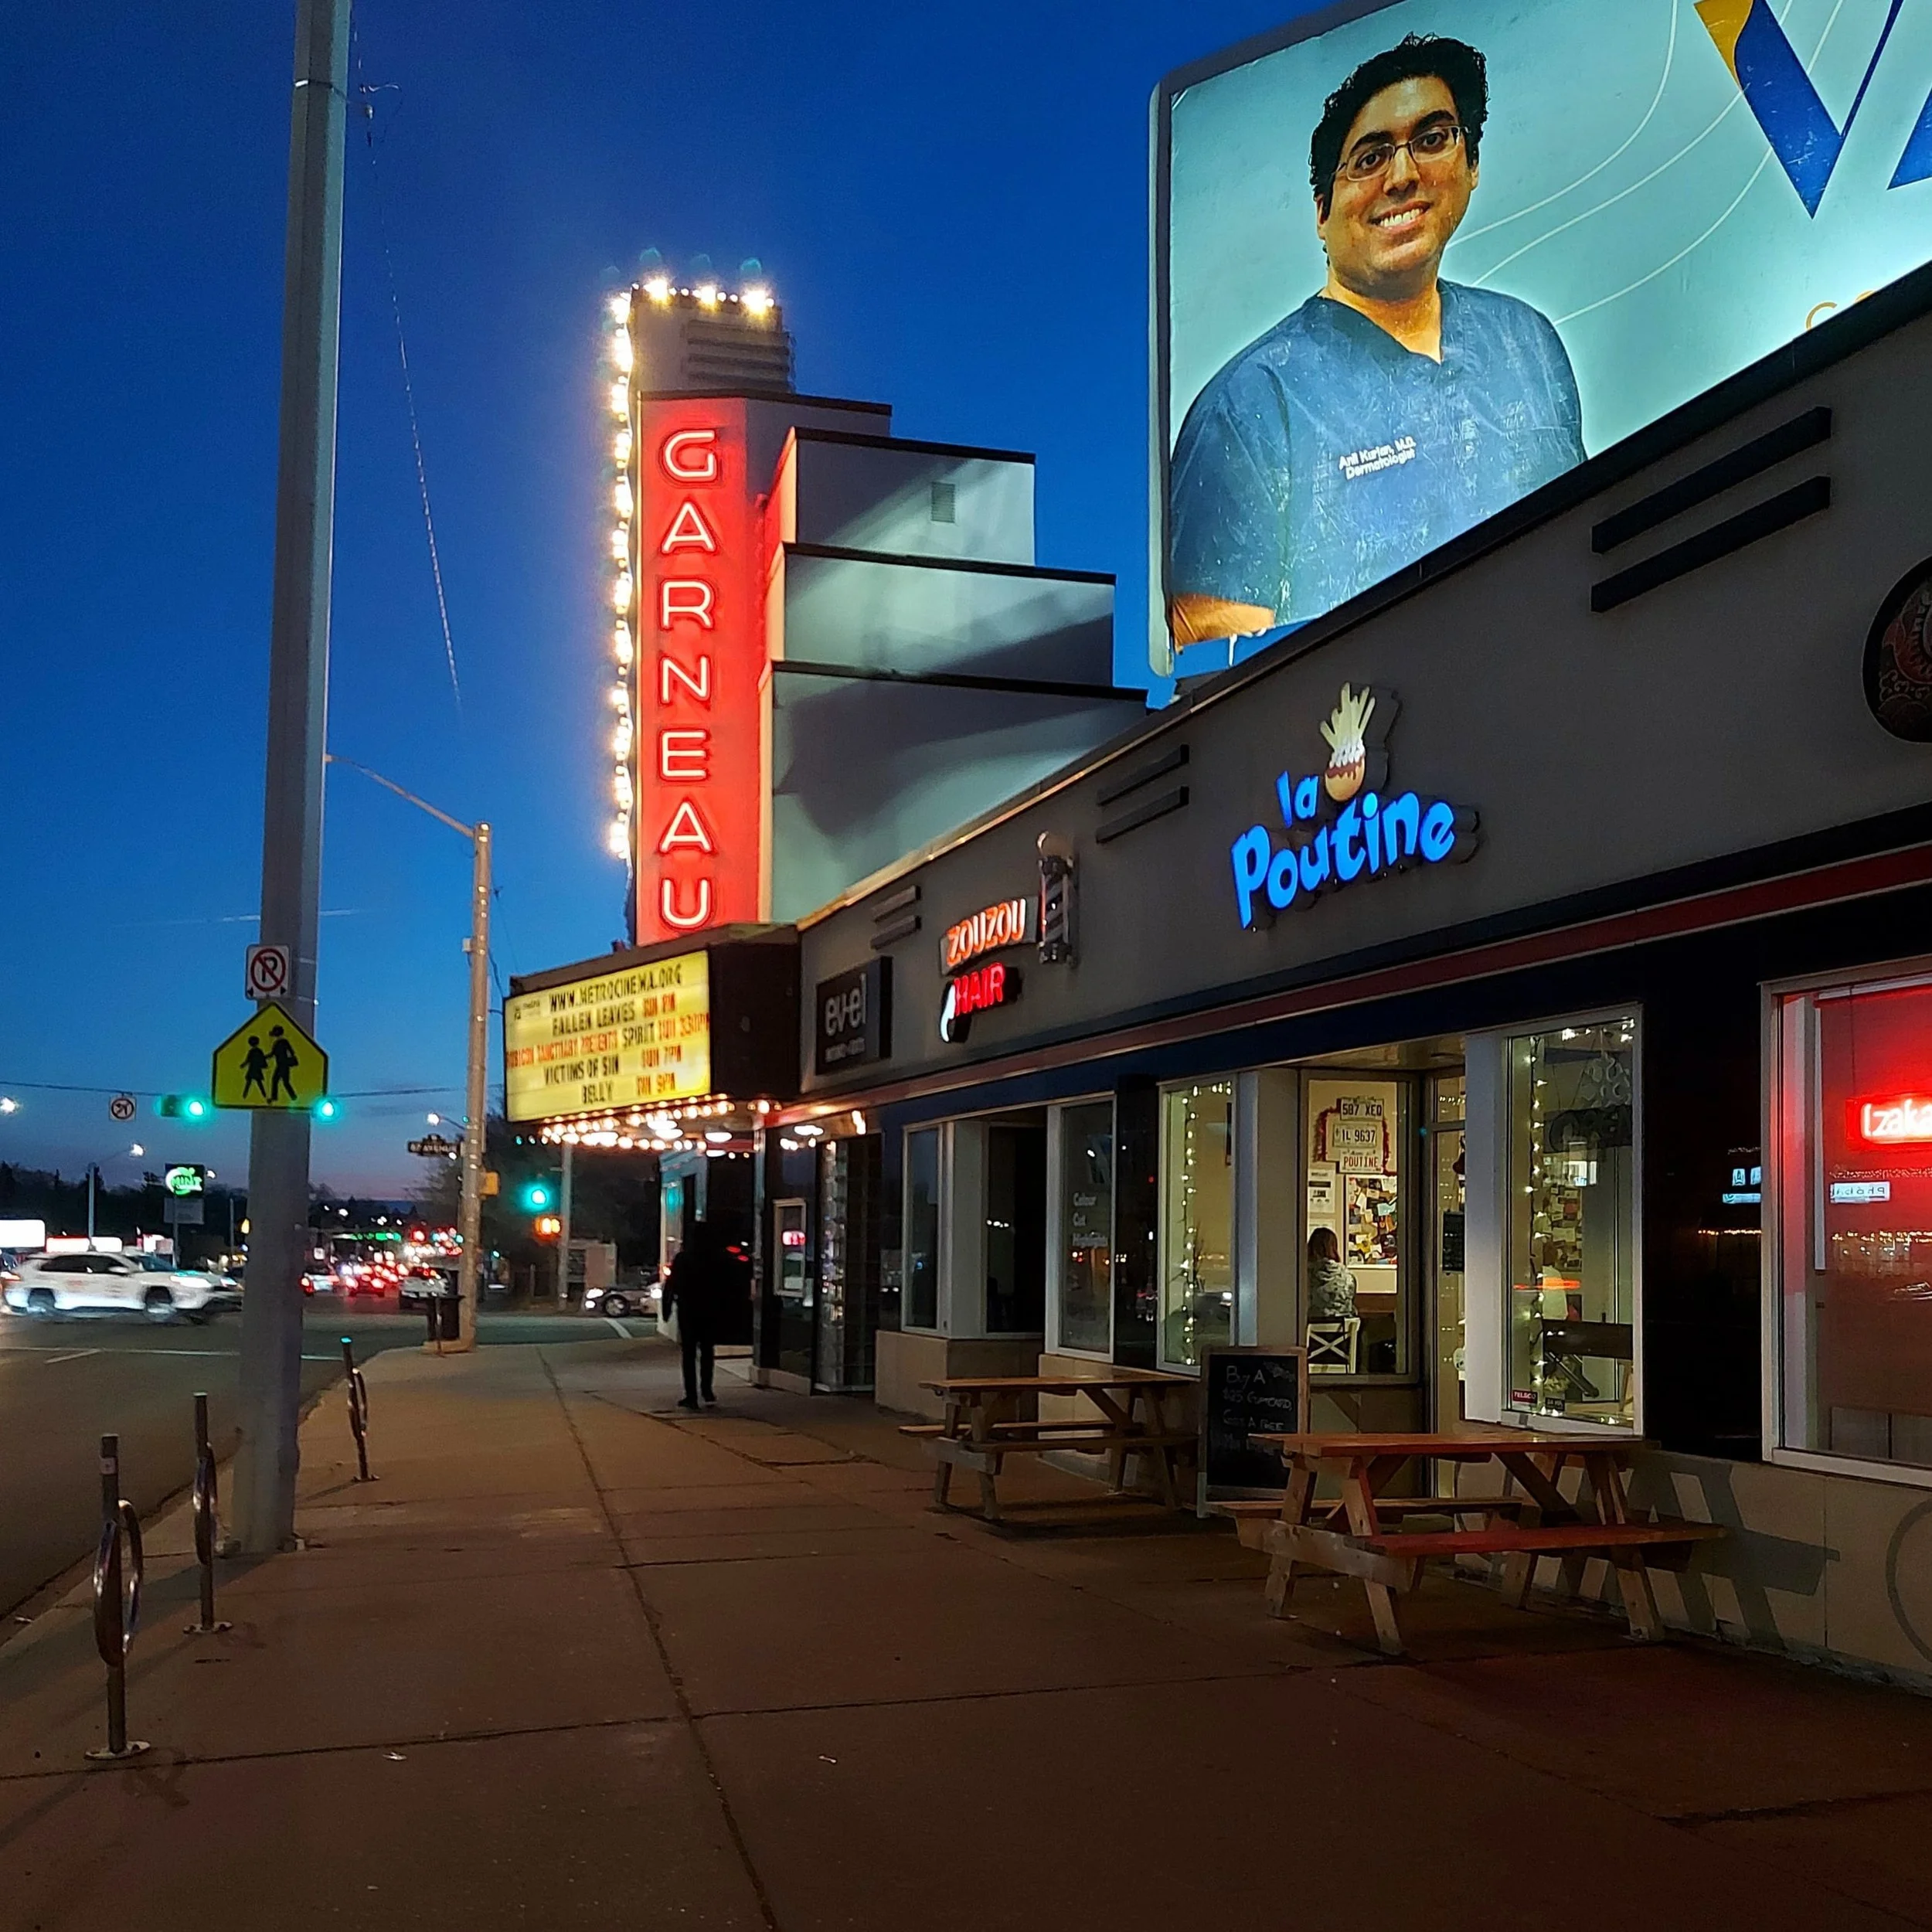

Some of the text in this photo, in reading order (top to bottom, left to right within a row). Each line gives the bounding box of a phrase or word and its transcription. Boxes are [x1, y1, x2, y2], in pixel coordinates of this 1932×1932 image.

[1338, 451, 1359, 471] Anil
[1345, 447, 1417, 480] Dermatologist
[661, 429, 716, 929] GARNEAU
[1276, 769, 1319, 828] la
[1230, 790, 1456, 930] Poutine
[946, 897, 1027, 967] ZOUZOU
[953, 961, 1005, 1016] HAIR
[552, 1010, 592, 1036] FALLEN
[596, 1001, 635, 1029] LEAVES
[621, 1021, 656, 1049] SPIRIT
[543, 1061, 584, 1085] VICTIMS
[586, 1056, 599, 1080] OF
[582, 1080, 614, 1105] BELLY
[1354, 1130, 1376, 1143] 9637
[1343, 1155, 1379, 1168] POUTINE
[1253, 1369, 1267, 1386] A
